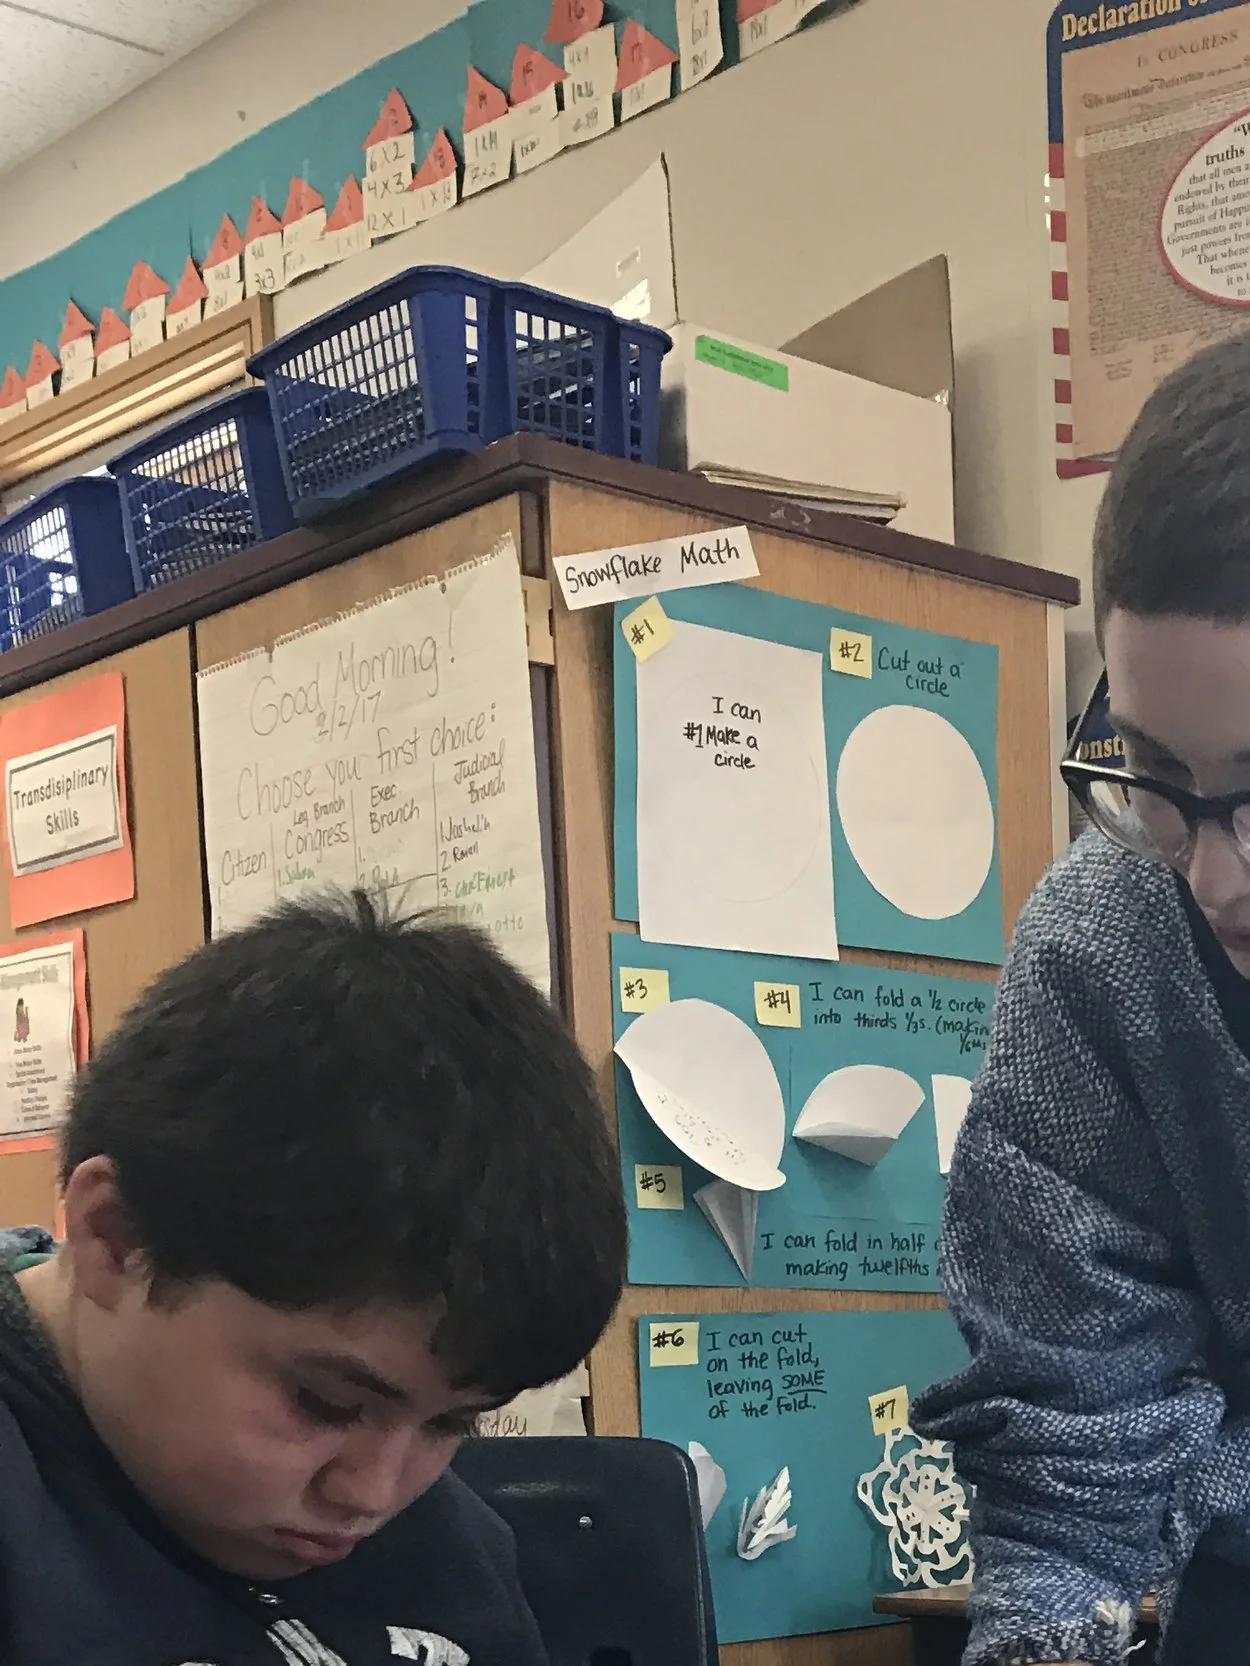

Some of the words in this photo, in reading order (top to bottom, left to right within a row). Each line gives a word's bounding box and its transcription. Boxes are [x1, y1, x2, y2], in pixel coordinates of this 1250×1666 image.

[1062, 0, 1181, 41] Declaration
[1205, 143, 1244, 166] truths
[1189, 171, 1206, 185] that
[1210, 168, 1220, 179] all
[1197, 253, 1217, 265] That
[1210, 260, 1247, 275] becomes
[564, 553, 662, 594] Snowflake
[680, 541, 740, 574] Math
[630, 618, 654, 645] #1
[838, 642, 864, 663] #2
[878, 647, 909, 672] Cut
[917, 654, 942, 676] out
[949, 661, 962, 679] a
[250, 662, 324, 736] Good
[905, 675, 950, 698] circle
[711, 696, 724, 714] I
[730, 702, 761, 724] can
[705, 726, 742, 747] Make
[746, 732, 760, 751] a
[237, 755, 316, 820] Choose
[377, 726, 420, 776] first
[454, 738, 506, 785] Judicial
[714, 752, 756, 770] circle
[14, 764, 108, 809] Transdisiplinary
[46, 807, 79, 835] Skills
[313, 796, 346, 821] Branch
[369, 797, 420, 834] Branch
[285, 821, 349, 864] Congress
[221, 850, 267, 886] Citizen
[624, 978, 648, 999] #3
[808, 982, 824, 1001] I
[833, 985, 864, 1003] can
[875, 985, 904, 1008] fold
[911, 995, 923, 1008] a
[948, 997, 986, 1014] circle
[764, 990, 792, 1014] #4
[814, 1008, 842, 1025] into
[854, 1012, 897, 1029] thirds
[639, 1171, 667, 1194] #5
[761, 1232, 775, 1250] I
[784, 1234, 816, 1249] can
[825, 1229, 858, 1253] fold
[868, 1235, 883, 1249] in
[891, 1232, 925, 1253] half
[785, 1259, 849, 1281] making
[858, 1256, 929, 1276] twelfths
[652, 1328, 685, 1348] #6
[706, 1331, 721, 1351] I
[729, 1331, 763, 1347] can
[771, 1323, 807, 1344] cut
[707, 1358, 728, 1372] on
[737, 1351, 768, 1369] the
[777, 1342, 819, 1370] fold,
[707, 1377, 773, 1400] leaving
[782, 1369, 827, 1395] SOME
[709, 1400, 729, 1419] of
[741, 1401, 768, 1418] the
[875, 1399, 896, 1419] #7
